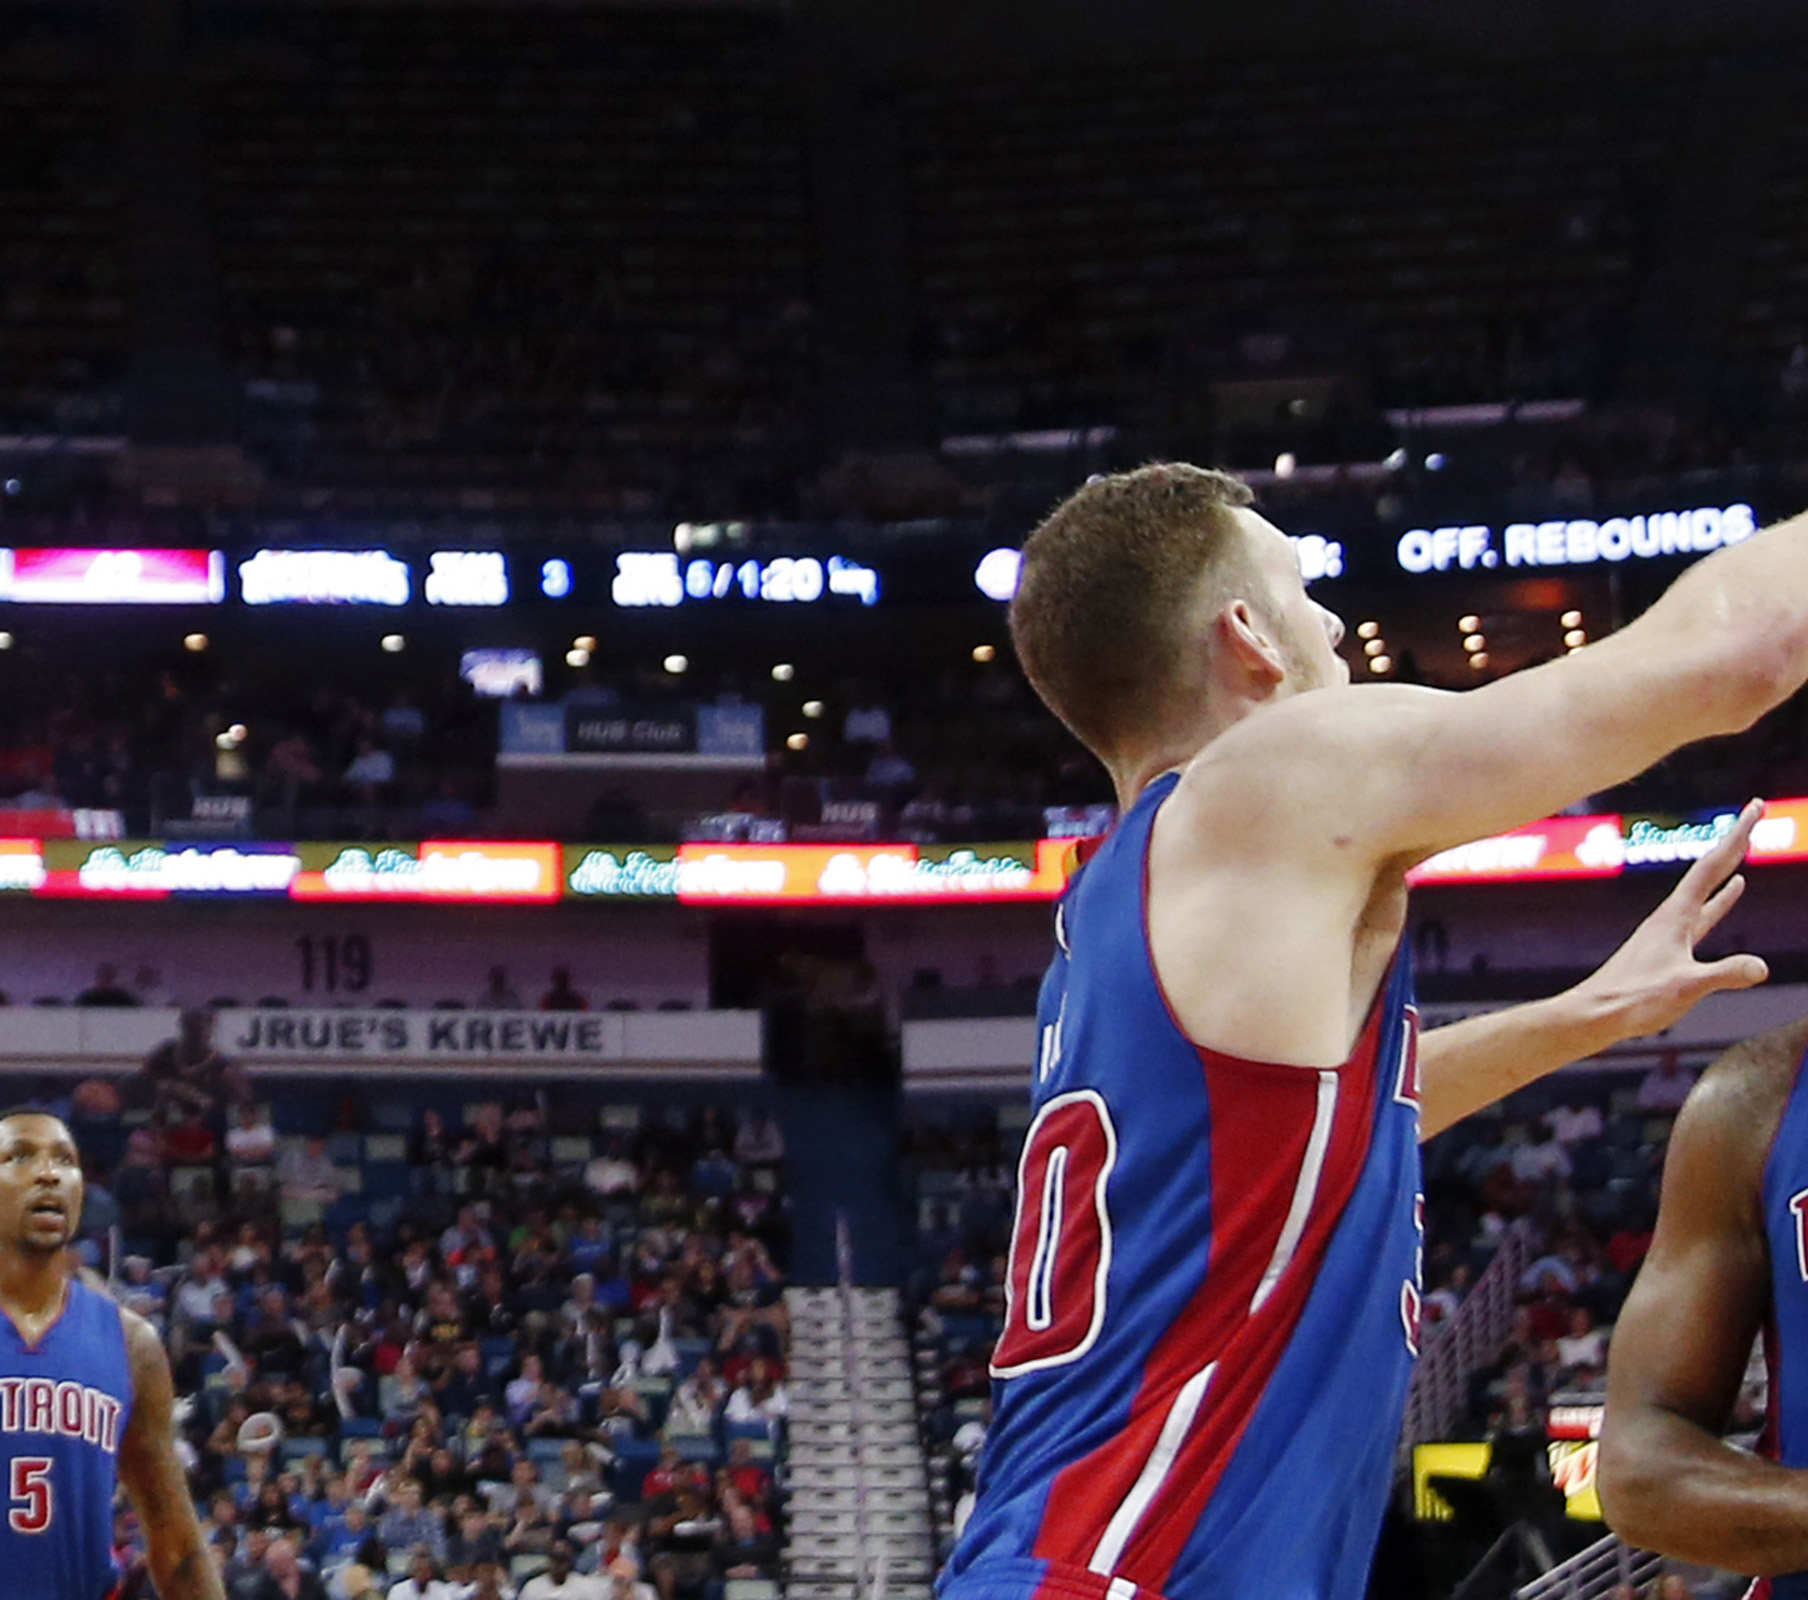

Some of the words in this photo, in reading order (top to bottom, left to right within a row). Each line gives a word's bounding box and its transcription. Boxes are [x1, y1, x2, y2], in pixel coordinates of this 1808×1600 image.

[1397, 524, 1499, 574] OFF.
[1503, 503, 1758, 567] REBOUNDS
[295, 934, 373, 993] 119
[237, 1017, 408, 1050] JRUE'S
[428, 1017, 605, 1052] KREWE
[0, 1376, 123, 1454] TROIT
[9, 1456, 54, 1533] 5
